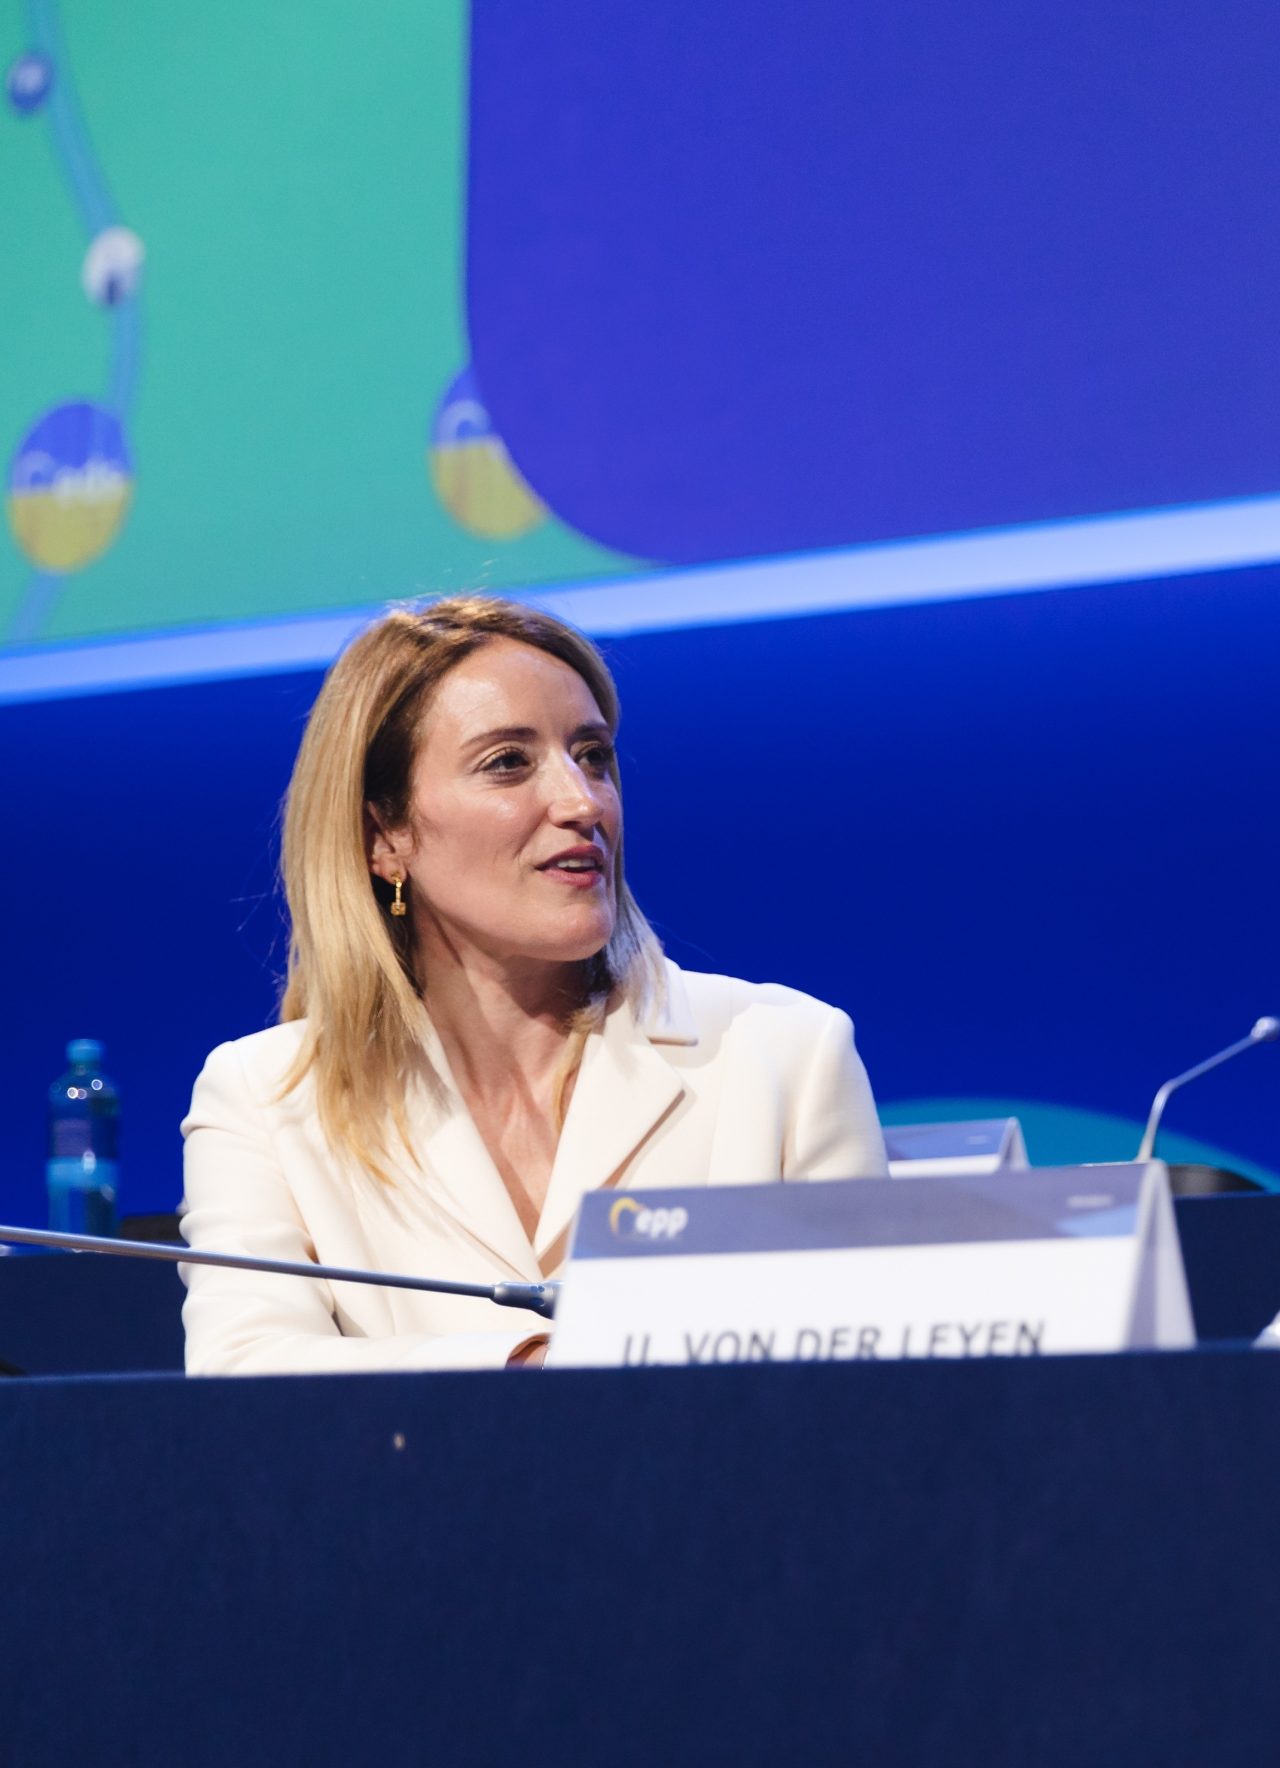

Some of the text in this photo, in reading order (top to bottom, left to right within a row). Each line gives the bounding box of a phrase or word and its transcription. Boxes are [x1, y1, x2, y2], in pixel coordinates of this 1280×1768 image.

[635, 1206, 689, 1240] epp
[684, 1327, 775, 1364] VON
[794, 1324, 882, 1361] DER
[901, 1318, 1045, 1359] LEYEN
